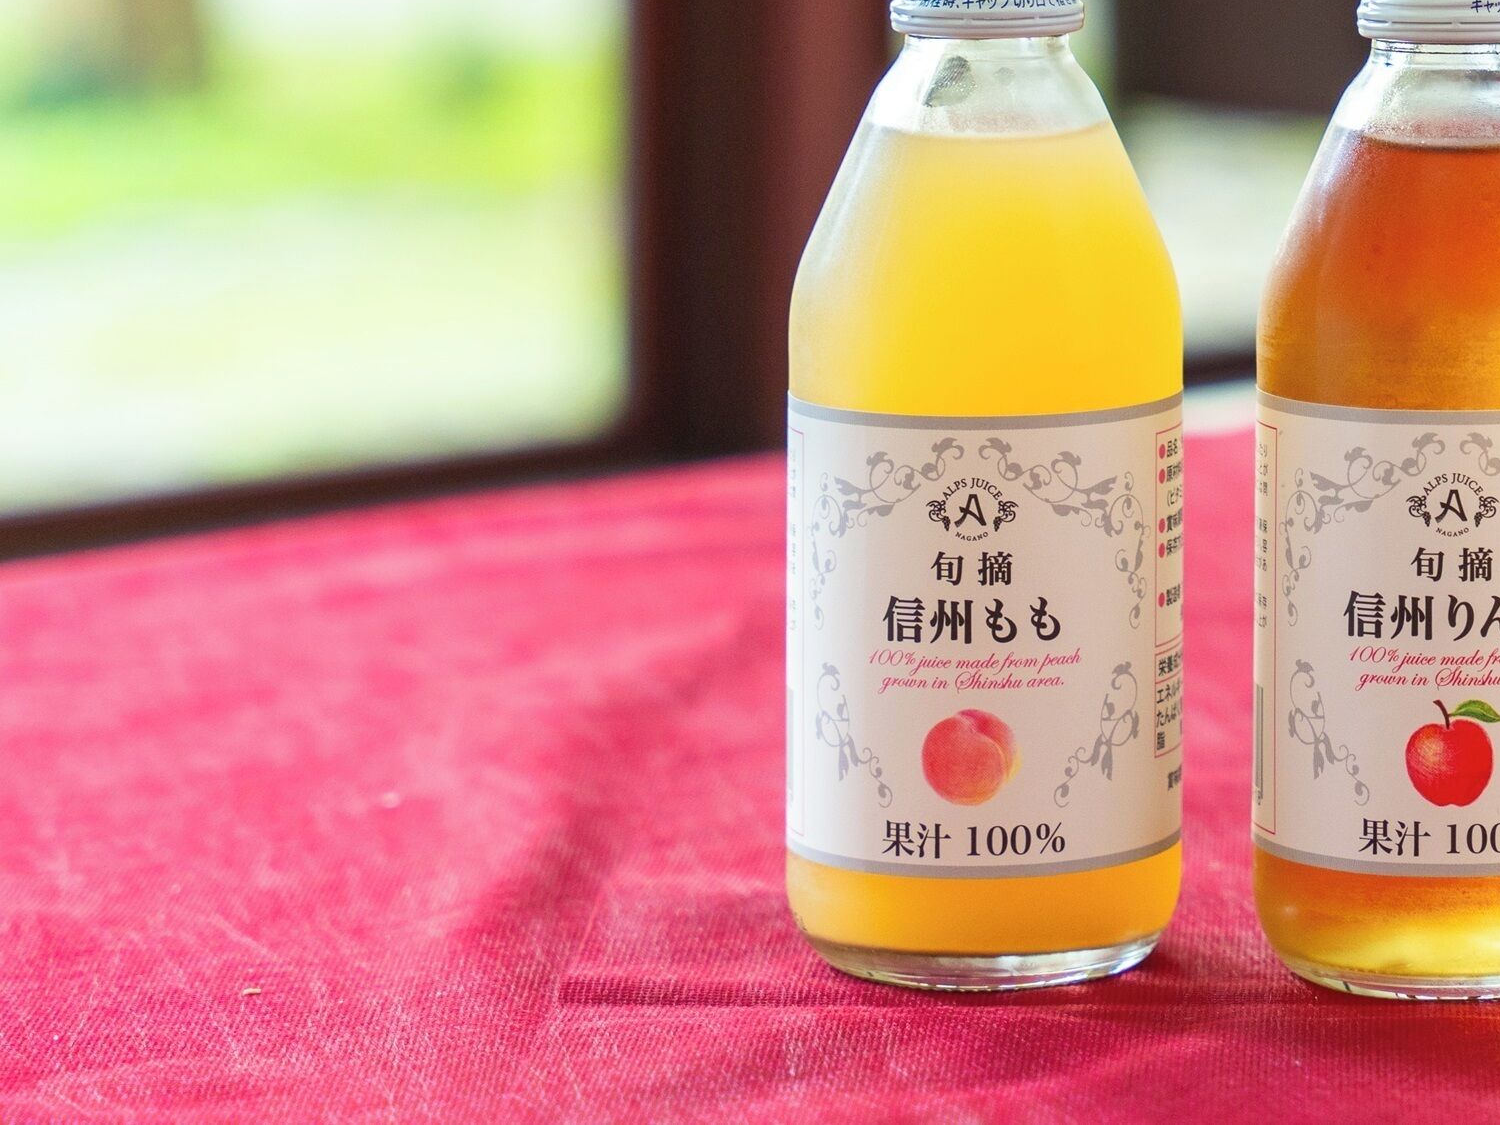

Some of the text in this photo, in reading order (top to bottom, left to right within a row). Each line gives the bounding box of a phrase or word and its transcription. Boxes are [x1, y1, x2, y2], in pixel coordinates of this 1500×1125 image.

[942, 477, 1003, 500] ALPS JUICE
[1423, 473, 1484, 496] ALPS JUICE
[955, 531, 988, 542] NAGANO
[1436, 527, 1469, 537] NAGANO
[931, 551, 1013, 587] 旬摘
[1410, 547, 1493, 583] 旬摘
[883, 595, 1061, 644] 信州もも
[868, 647, 1082, 675] 100% juice made from peach
[1349, 645, 1399, 662] 100%
[1392, 652, 1436, 674] juice
[1440, 649, 1483, 666] made
[877, 670, 1065, 694] grown in Shinshu area.
[1355, 672, 1407, 691] grown
[1411, 673, 1429, 686] in
[881, 820, 1066, 859] 果汁 100%
[1358, 818, 1431, 858] 果汁
